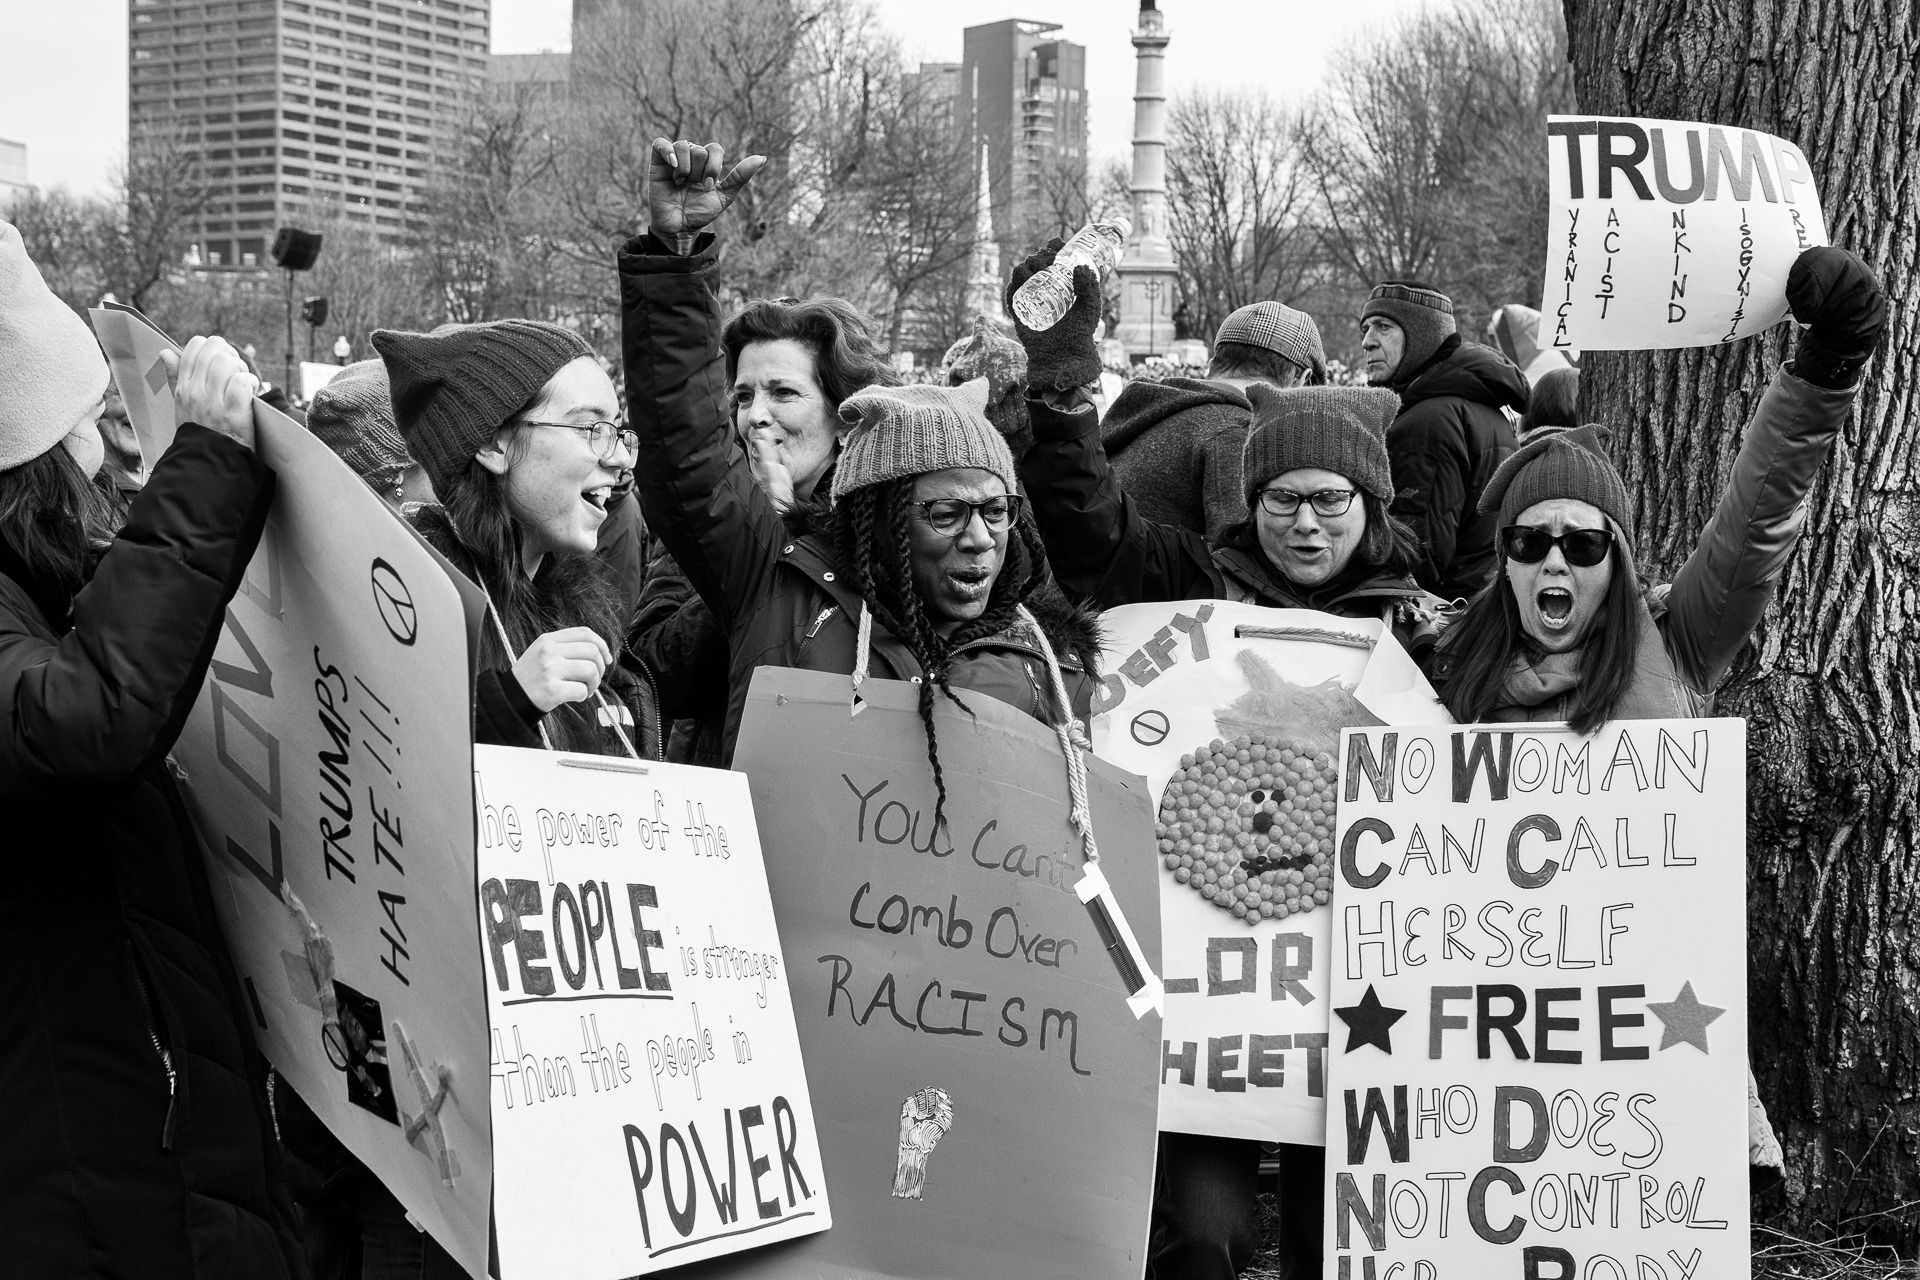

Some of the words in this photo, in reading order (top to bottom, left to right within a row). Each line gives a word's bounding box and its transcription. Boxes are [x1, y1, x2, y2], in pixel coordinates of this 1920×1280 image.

[1547, 121, 1809, 204] TRUMP
[1595, 207, 1620, 320] ACIST
[1668, 208, 1692, 324] NKIND
[1092, 603, 1215, 718] DEFY
[314, 645, 356, 884] TRUMPS
[1344, 732, 1435, 803] NO
[1451, 729, 1708, 803] WOMAN
[474, 771, 522, 853] he
[536, 808, 622, 886] power
[638, 790, 670, 851] of
[684, 800, 731, 860] the
[1340, 817, 1485, 889] CAN
[1506, 813, 1697, 889] CALL
[481, 877, 673, 996] PEOPLE
[676, 926, 698, 977] is
[703, 925, 778, 1009] stronger
[985, 906, 1078, 968] Over
[1164, 932, 1316, 1007] OR
[1345, 901, 1634, 980] HERSELF
[490, 1024, 577, 1109] than
[580, 1013, 632, 1092] the
[646, 1002, 716, 1111] people
[729, 1015, 752, 1064] in
[1162, 1032, 1329, 1098] HEET
[1428, 984, 1650, 1065] FREE
[1344, 1084, 1478, 1165] WHO
[1493, 1085, 1664, 1169] DOES
[1336, 1172, 1466, 1251] NOT
[1467, 1165, 1728, 1245] CONTROL
